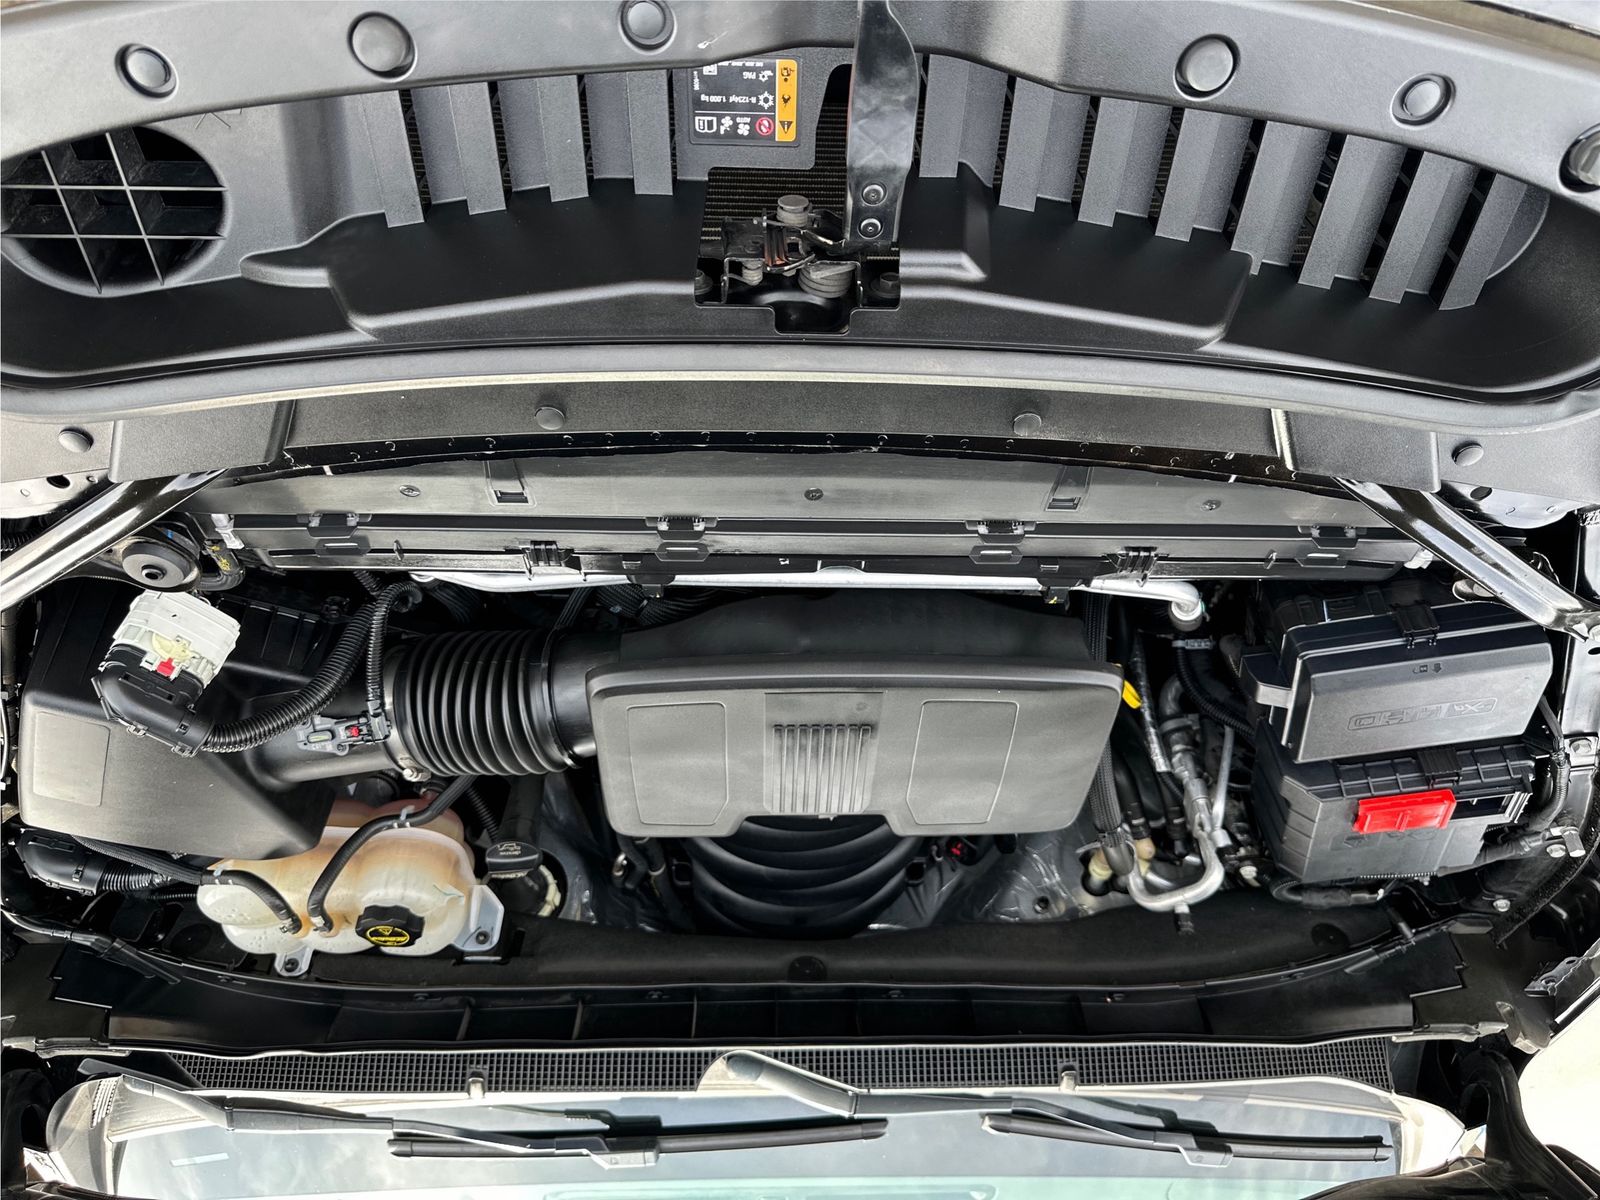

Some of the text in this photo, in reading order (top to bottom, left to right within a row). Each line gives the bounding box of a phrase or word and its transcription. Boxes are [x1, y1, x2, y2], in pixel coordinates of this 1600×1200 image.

[700, 94, 757, 103] R-1234yf 1.000 kg
